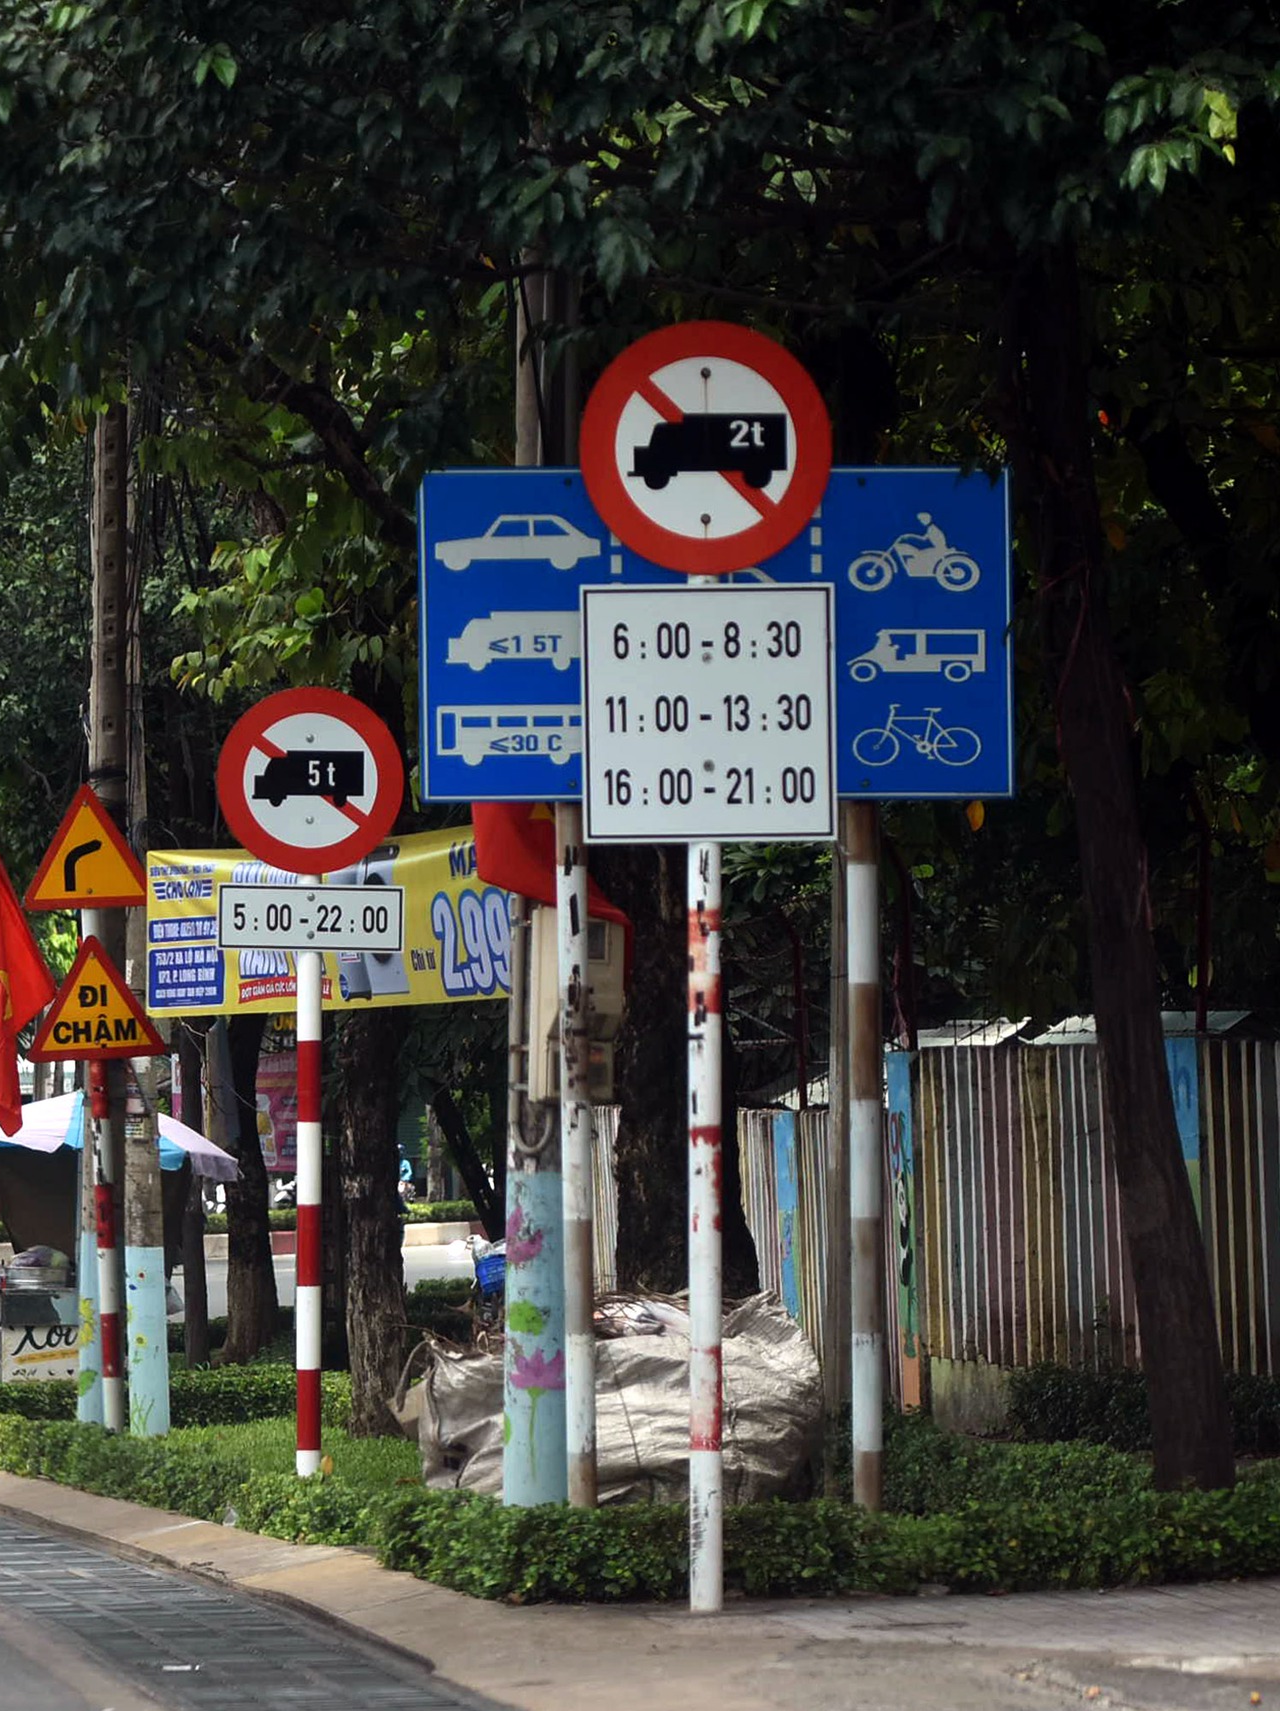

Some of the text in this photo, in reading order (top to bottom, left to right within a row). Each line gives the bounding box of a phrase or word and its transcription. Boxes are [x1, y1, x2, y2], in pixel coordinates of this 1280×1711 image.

[730, 420, 765, 447] 2t
[78, 985, 108, 1008] ĐI
[53, 1014, 138, 1049] CHẬM
